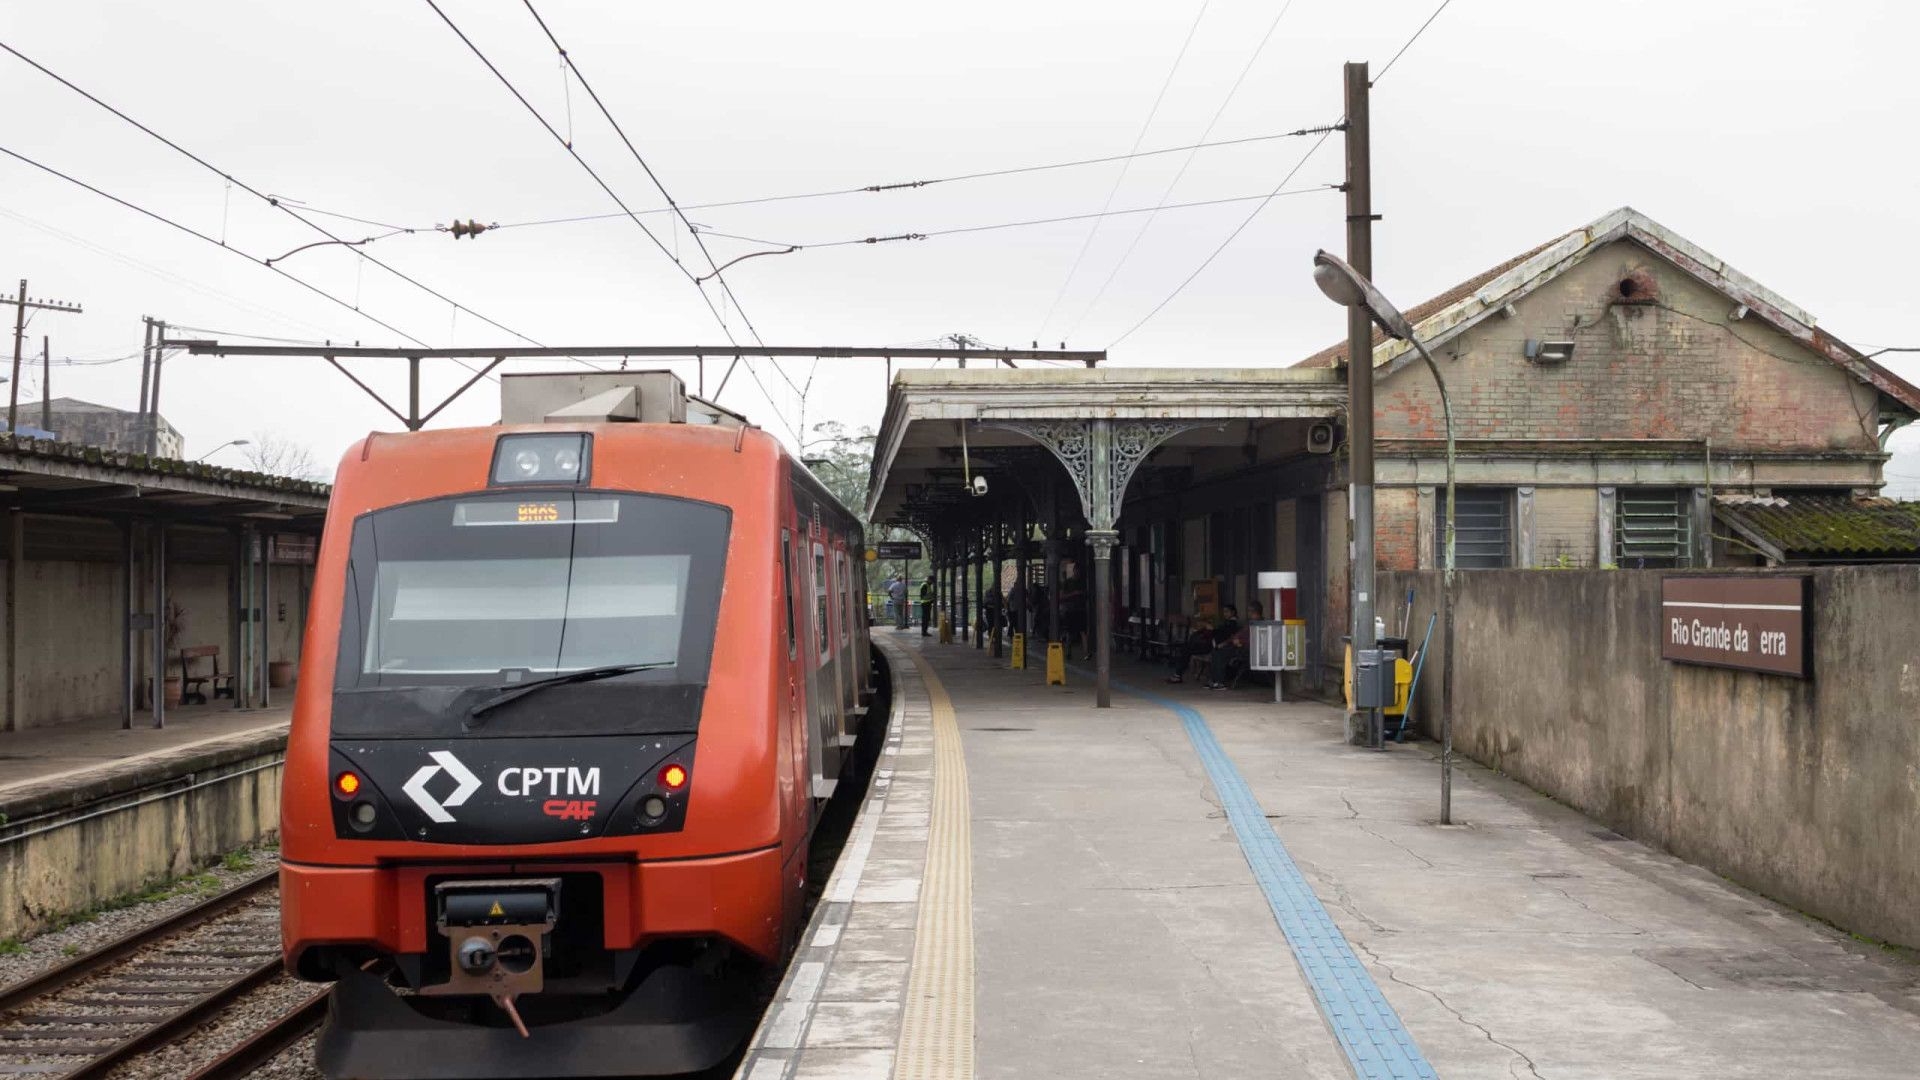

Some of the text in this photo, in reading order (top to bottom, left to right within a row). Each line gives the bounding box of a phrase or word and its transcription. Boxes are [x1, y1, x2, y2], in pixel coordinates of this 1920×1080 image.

[1671, 618, 1786, 656] Rio Grande da erra
[498, 767, 600, 796] CPTM
[543, 800, 597, 820] CAF
